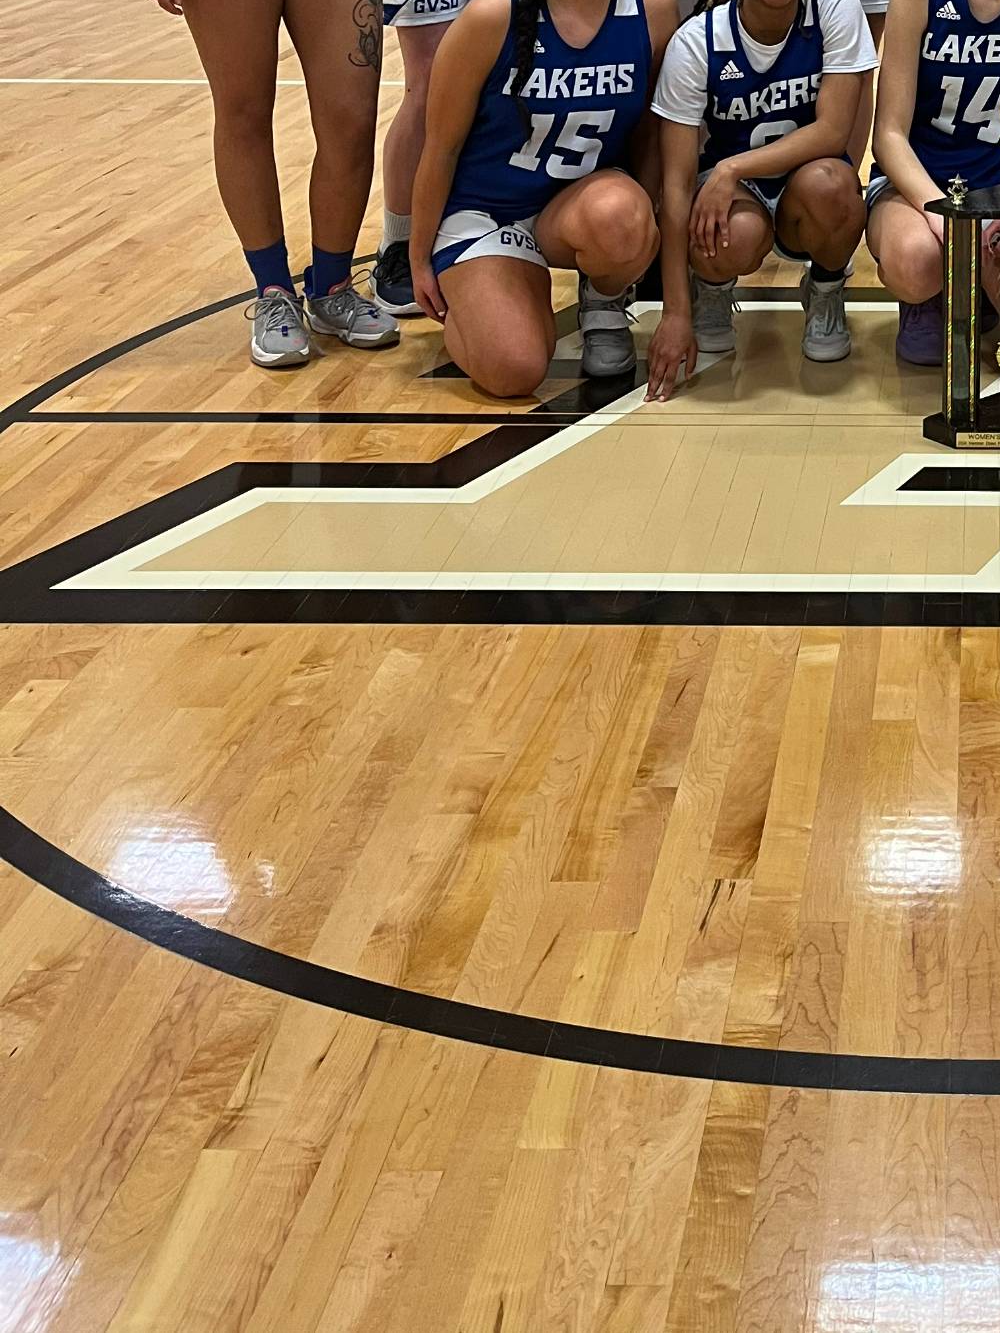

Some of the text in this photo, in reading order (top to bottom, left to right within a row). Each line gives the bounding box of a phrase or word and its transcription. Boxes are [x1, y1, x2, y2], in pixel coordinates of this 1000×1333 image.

[935, 11, 962, 21] adidas
[719, 71, 745, 81] adidas
[712, 71, 823, 121] LAKERS
[508, 109, 616, 180] 15
[967, 433, 1000, 441] WOMEN'S
